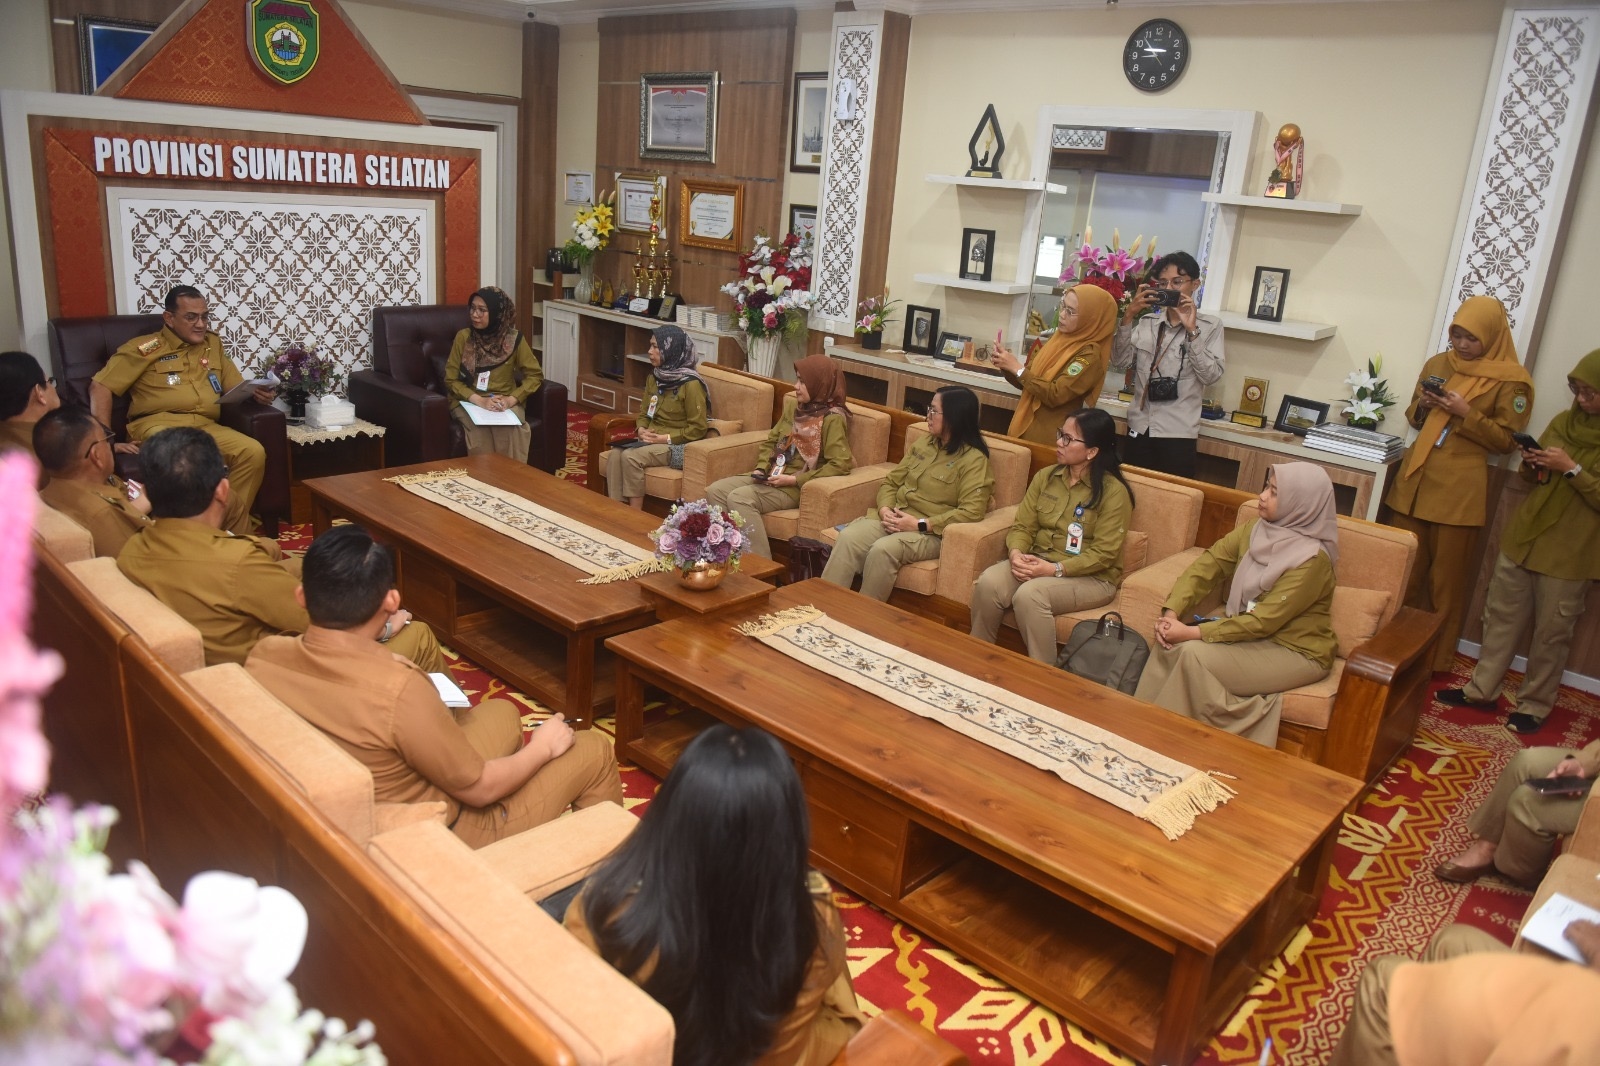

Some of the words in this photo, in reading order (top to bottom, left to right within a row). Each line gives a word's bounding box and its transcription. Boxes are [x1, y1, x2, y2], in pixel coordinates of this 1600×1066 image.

[1145, 30, 1152, 39] 11
[1156, 27, 1164, 36] 12
[1168, 30, 1172, 39] 1
[1136, 39, 1144, 48] 10
[1173, 39, 1180, 48] 2
[1132, 51, 1138, 60] 9
[1174, 51, 1181, 60] 3
[1133, 63, 1139, 72] 8
[1170, 64, 1176, 72] 4
[1140, 73, 1146, 81] 7
[1149, 76, 1156, 85] 6
[1160, 73, 1167, 81] 5
[93, 136, 224, 178] PROVINSI
[232, 145, 358, 184] SUMATERA
[365, 154, 450, 189] SELATAN
